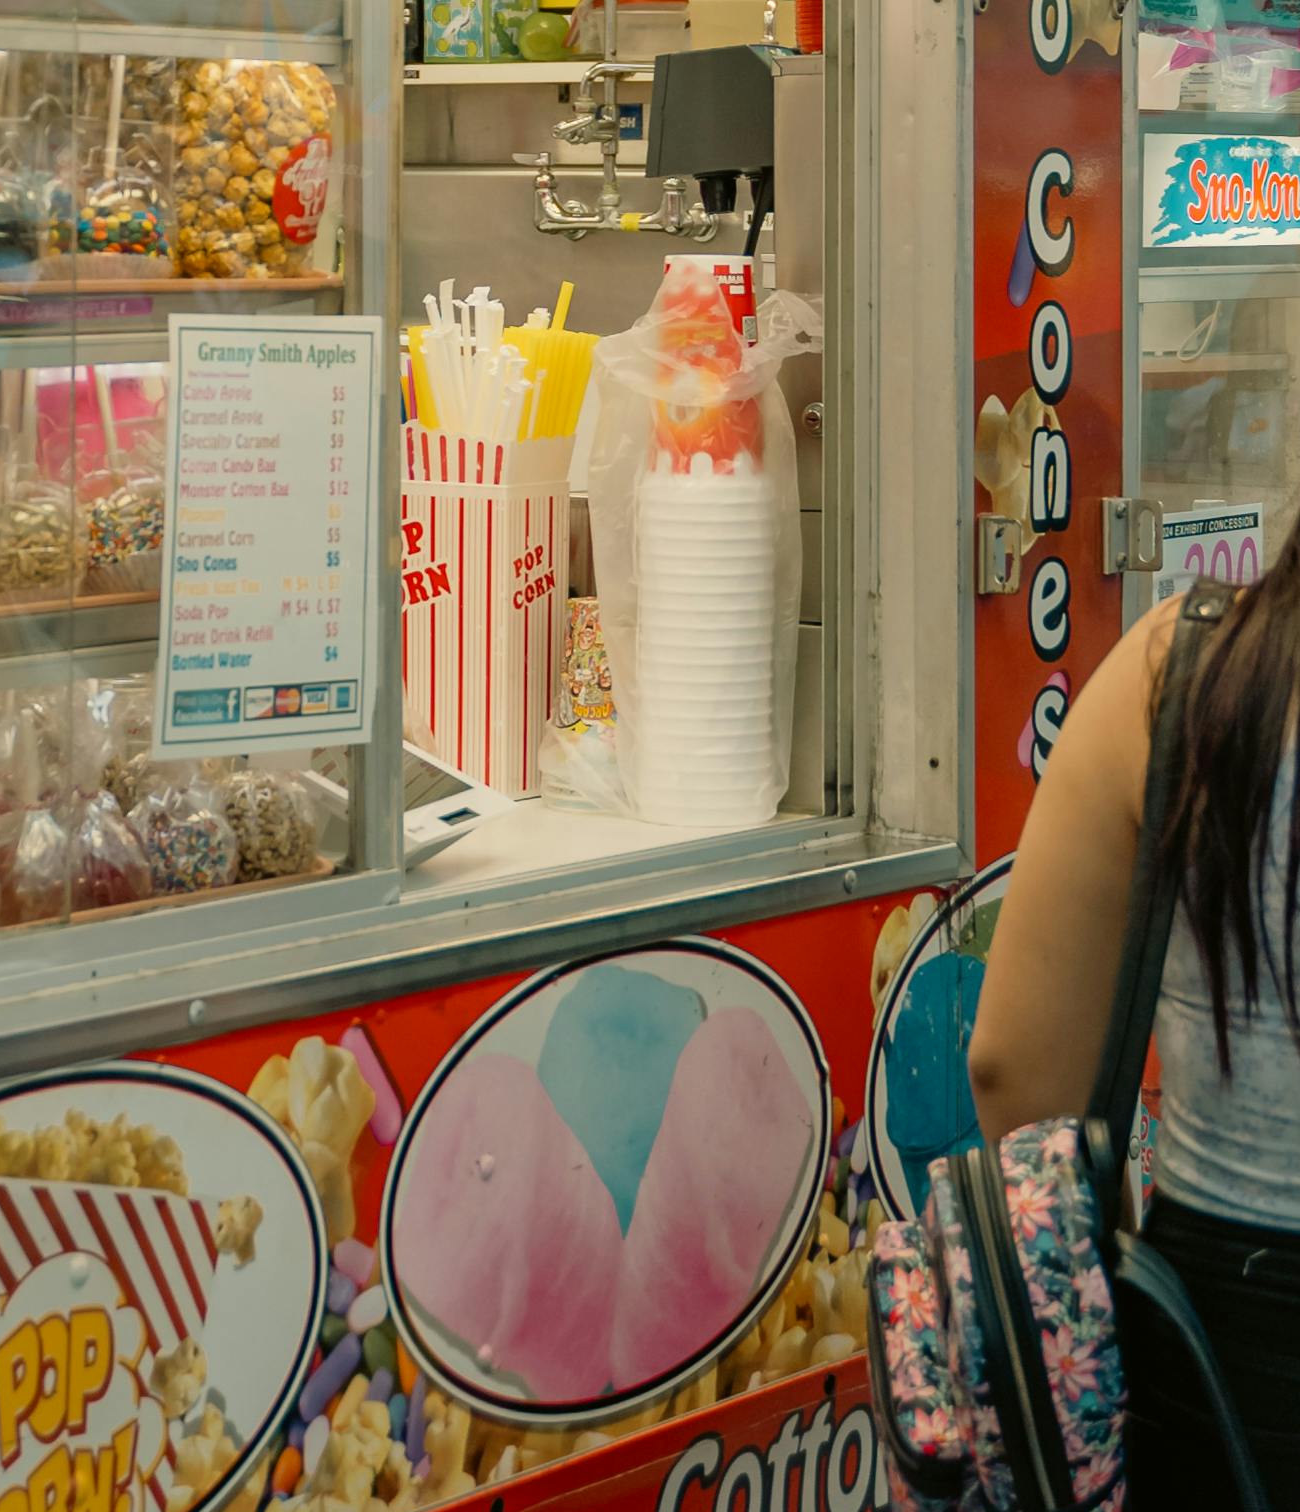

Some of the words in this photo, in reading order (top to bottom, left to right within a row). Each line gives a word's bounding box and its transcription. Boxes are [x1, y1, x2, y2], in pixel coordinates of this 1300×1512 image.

[198, 341, 255, 368] Granny
[258, 342, 303, 364] Smith
[306, 343, 357, 369] Apples
[183, 384, 216, 401] Candy
[182, 409, 228, 426] Caramel
[235, 433, 280, 449] Caramel
[180, 458, 216, 474] Cotton
[222, 458, 254, 474] Candy
[1029, 146, 1076, 781] Cones
[179, 483, 226, 498] Monster
[231, 482, 266, 497] Cotton
[1175, 522, 1204, 536] EXHIBIT
[1208, 515, 1255, 532] CONCESSION
[177, 531, 225, 548] Caramel
[228, 531, 255, 546] Corn
[176, 555, 199, 573] Sno
[203, 554, 238, 572] Cones
[512, 543, 545, 580] POP
[512, 569, 556, 612] CORN
[175, 605, 203, 622] Soda
[281, 599, 291, 617] M
[173, 630, 206, 647] Large
[210, 628, 241, 645] Drink
[245, 625, 275, 642] Refill
[172, 653, 215, 671] Bottled
[218, 652, 253, 669] Water
